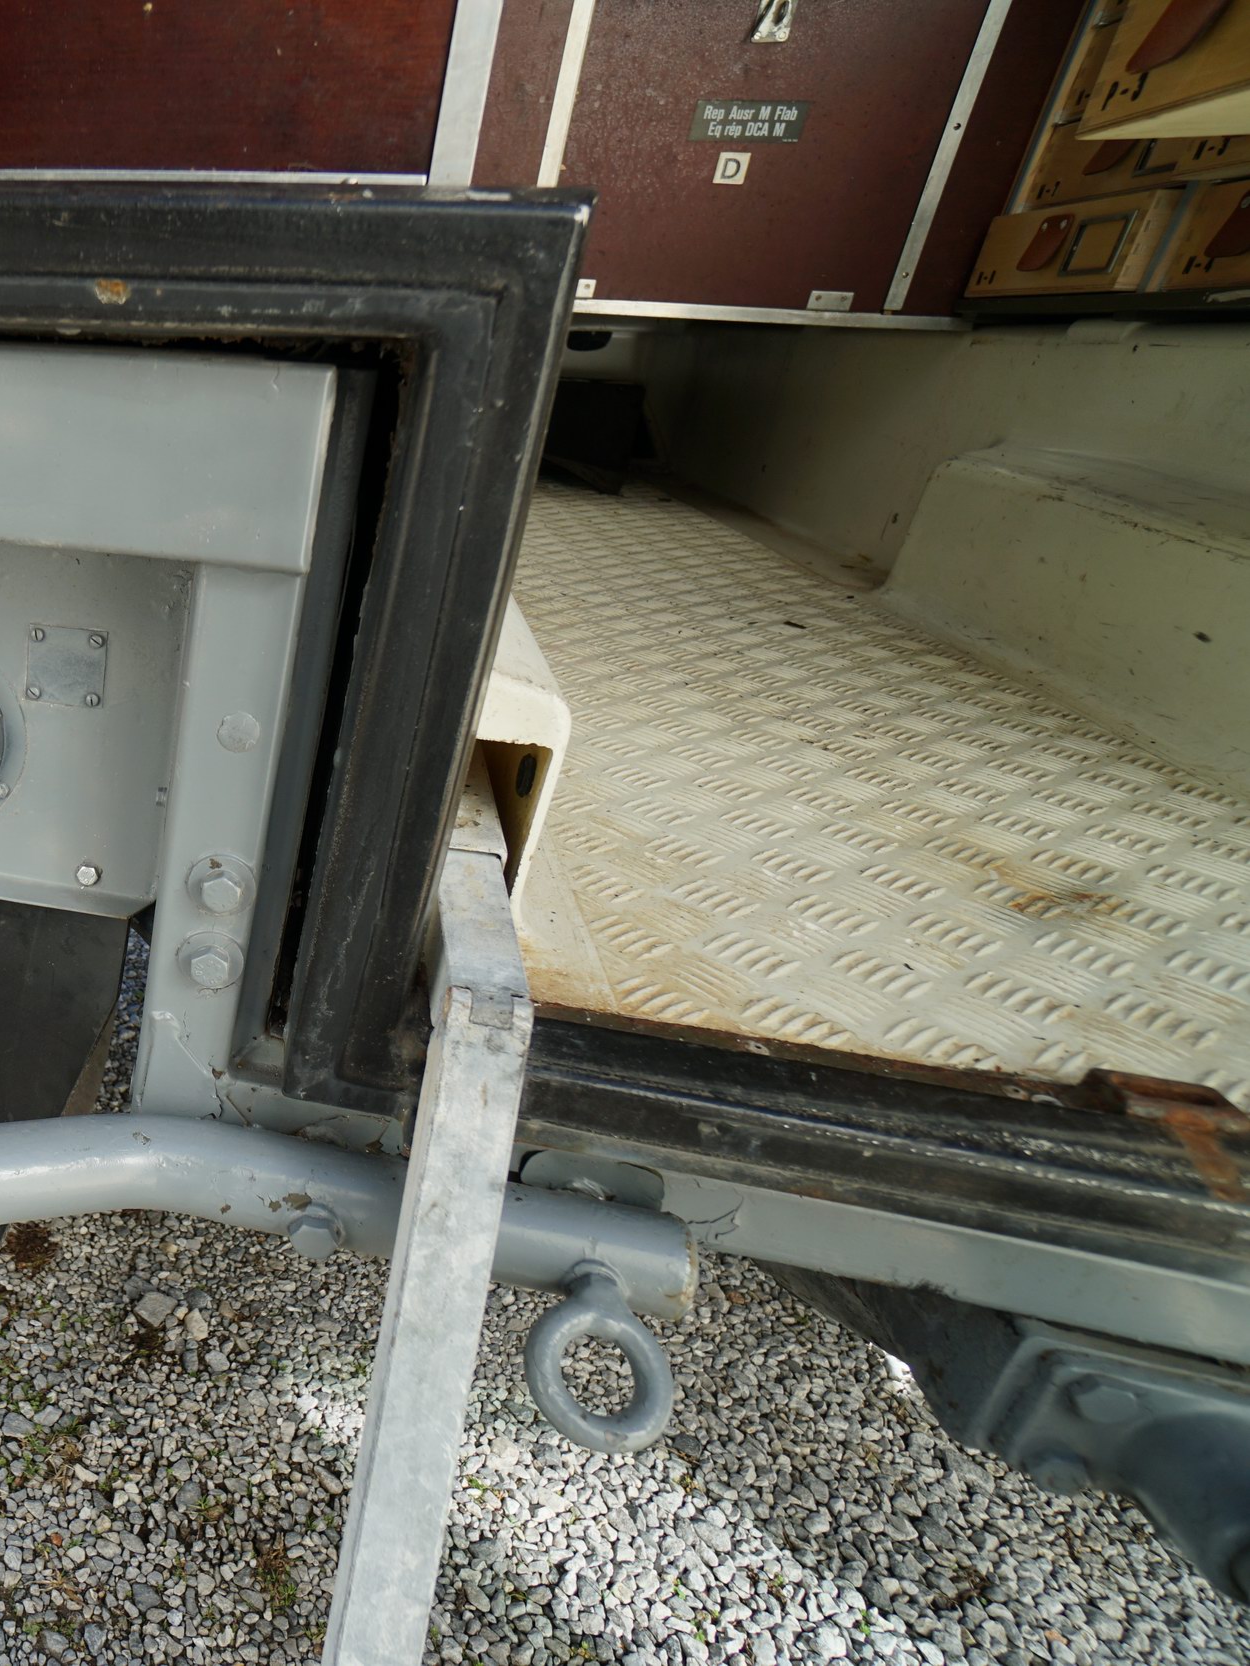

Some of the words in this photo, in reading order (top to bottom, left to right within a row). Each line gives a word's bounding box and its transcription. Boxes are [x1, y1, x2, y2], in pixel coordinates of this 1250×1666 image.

[704, 105, 725, 121] Rep
[728, 105, 755, 120] Ausr
[758, 106, 772, 120] M
[774, 106, 798, 120] Flab
[707, 121, 722, 138] Eq
[724, 122, 742, 138] rép
[744, 122, 769, 136] DCA
[772, 122, 785, 136] M
[720, 158, 741, 179] D
